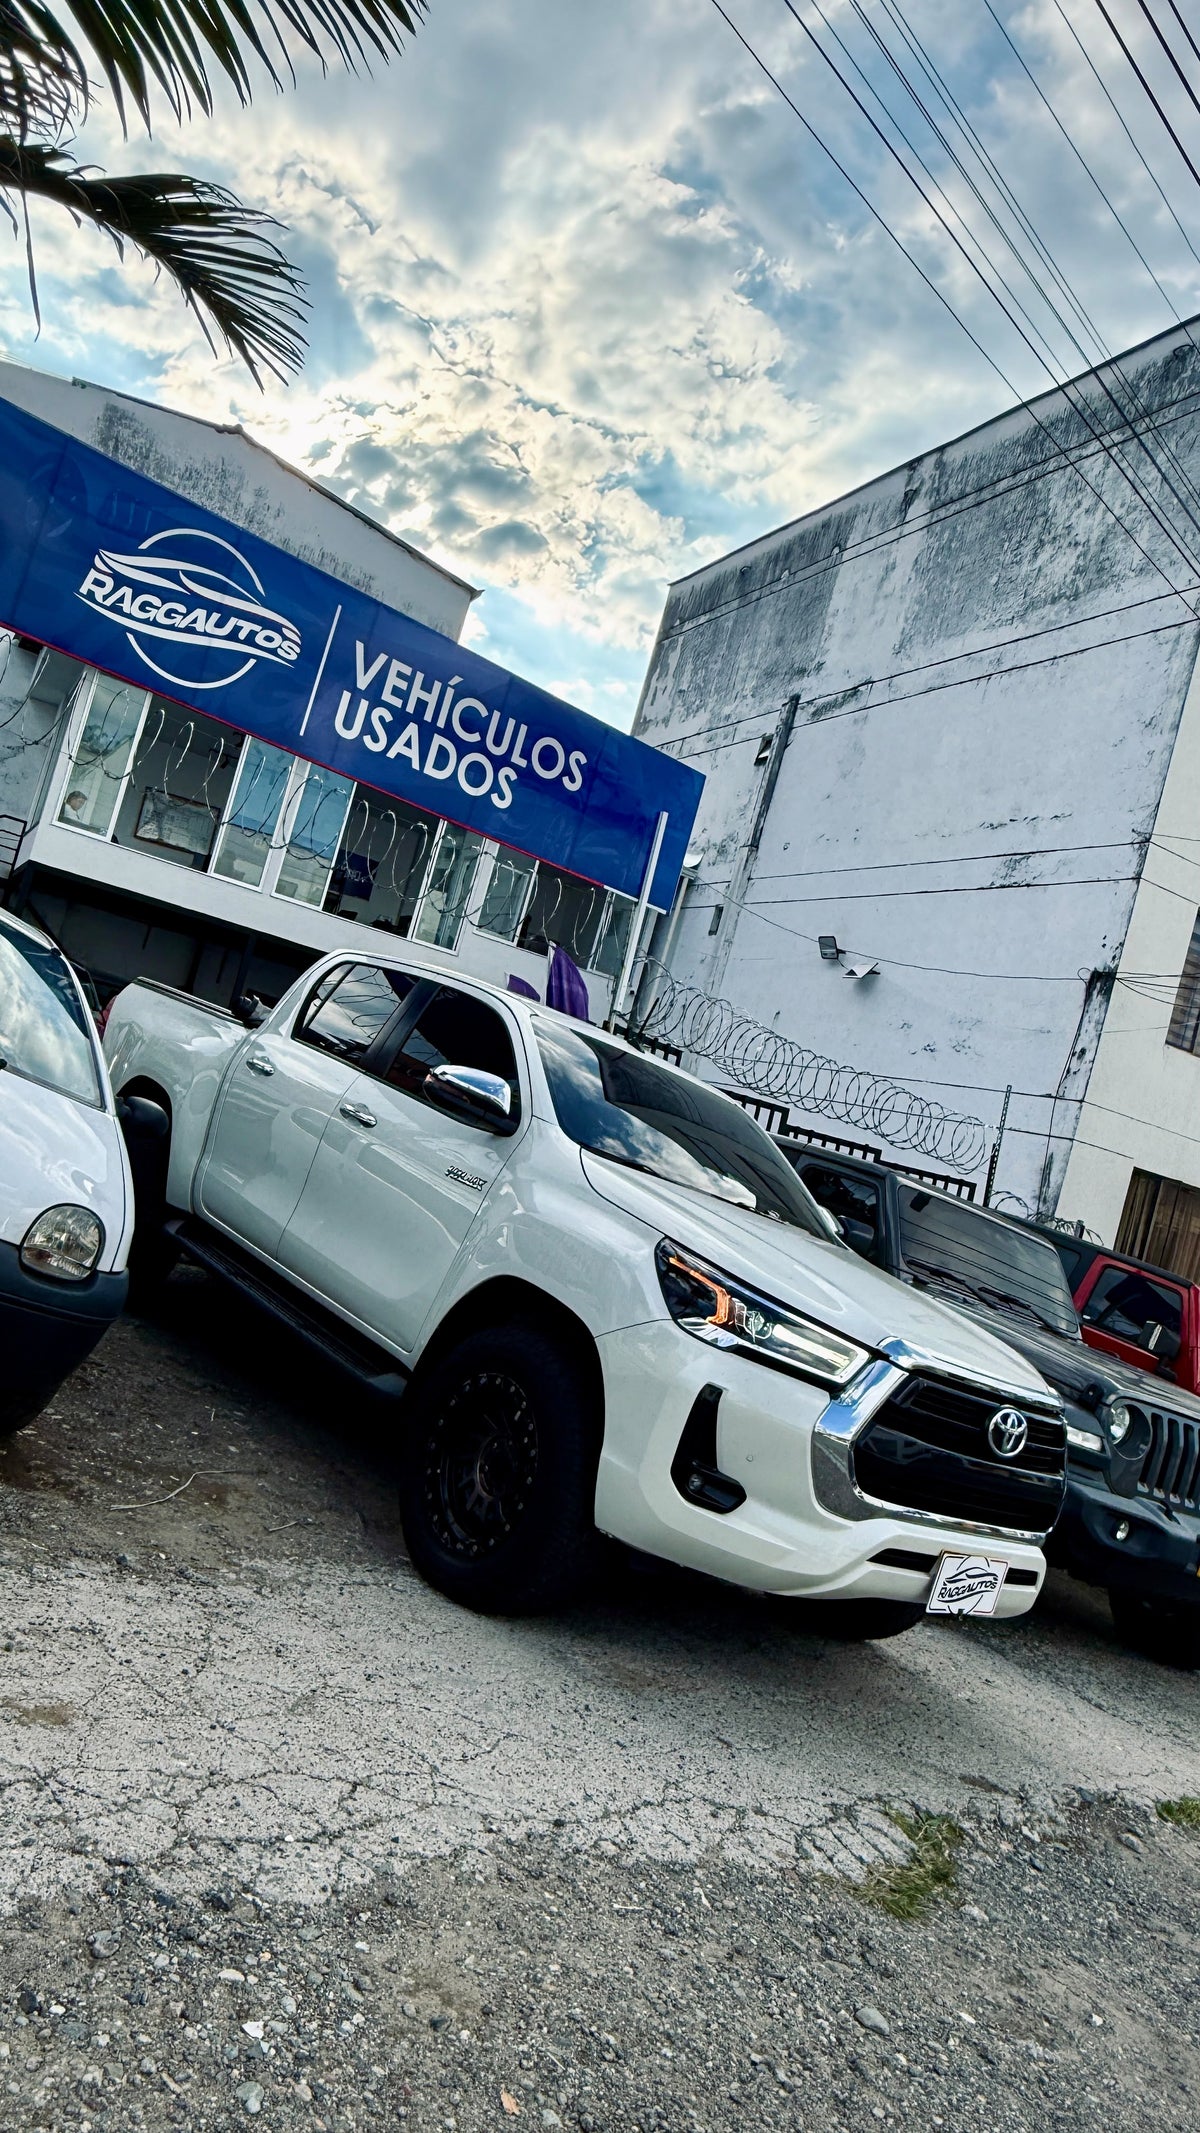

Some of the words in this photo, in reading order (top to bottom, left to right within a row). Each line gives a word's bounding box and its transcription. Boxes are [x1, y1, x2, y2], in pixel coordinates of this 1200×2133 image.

[79, 568, 301, 661] RAGGAUTOS
[334, 690, 518, 809] USADOS
[354, 640, 588, 792] VEHÍCULOS
[937, 1580, 998, 1599] RAGGAUTOS
